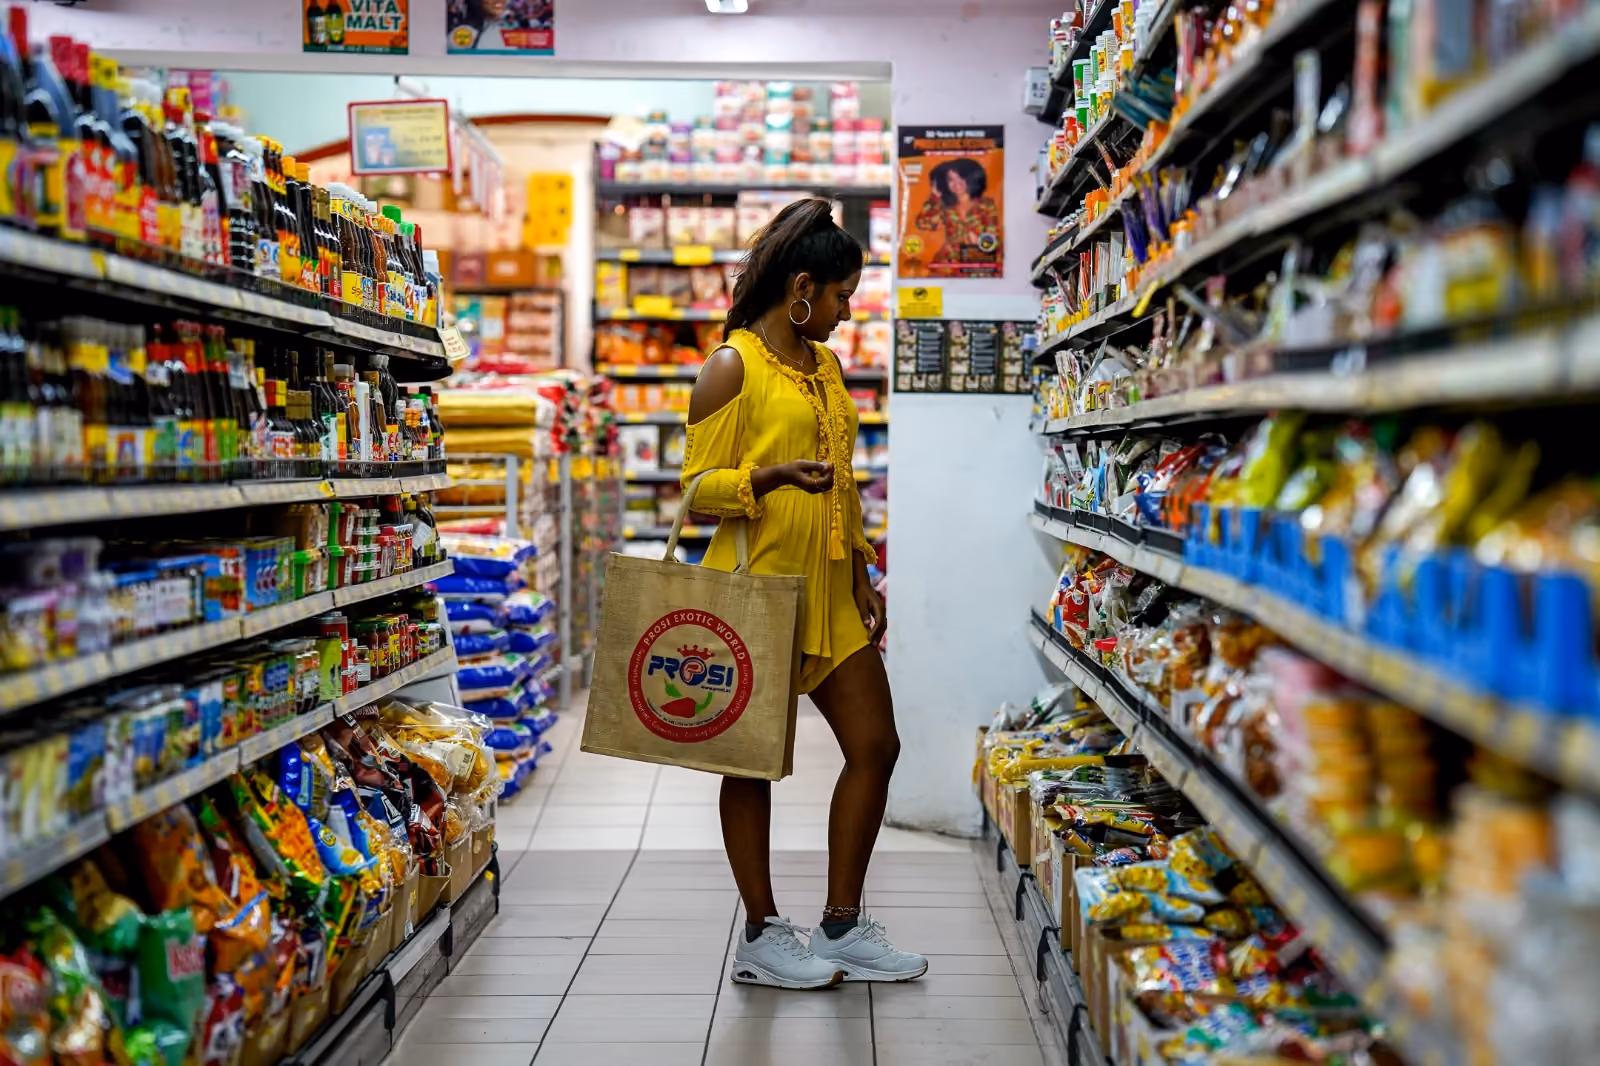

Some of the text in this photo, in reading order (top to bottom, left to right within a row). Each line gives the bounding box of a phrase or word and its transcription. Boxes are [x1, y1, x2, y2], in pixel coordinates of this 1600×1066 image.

[351, 0, 398, 13] VITA
[347, 15, 402, 30] MALT
[643, 612, 746, 660] PROSI EXOTIC WORLD
[648, 655, 734, 687] PROSI
